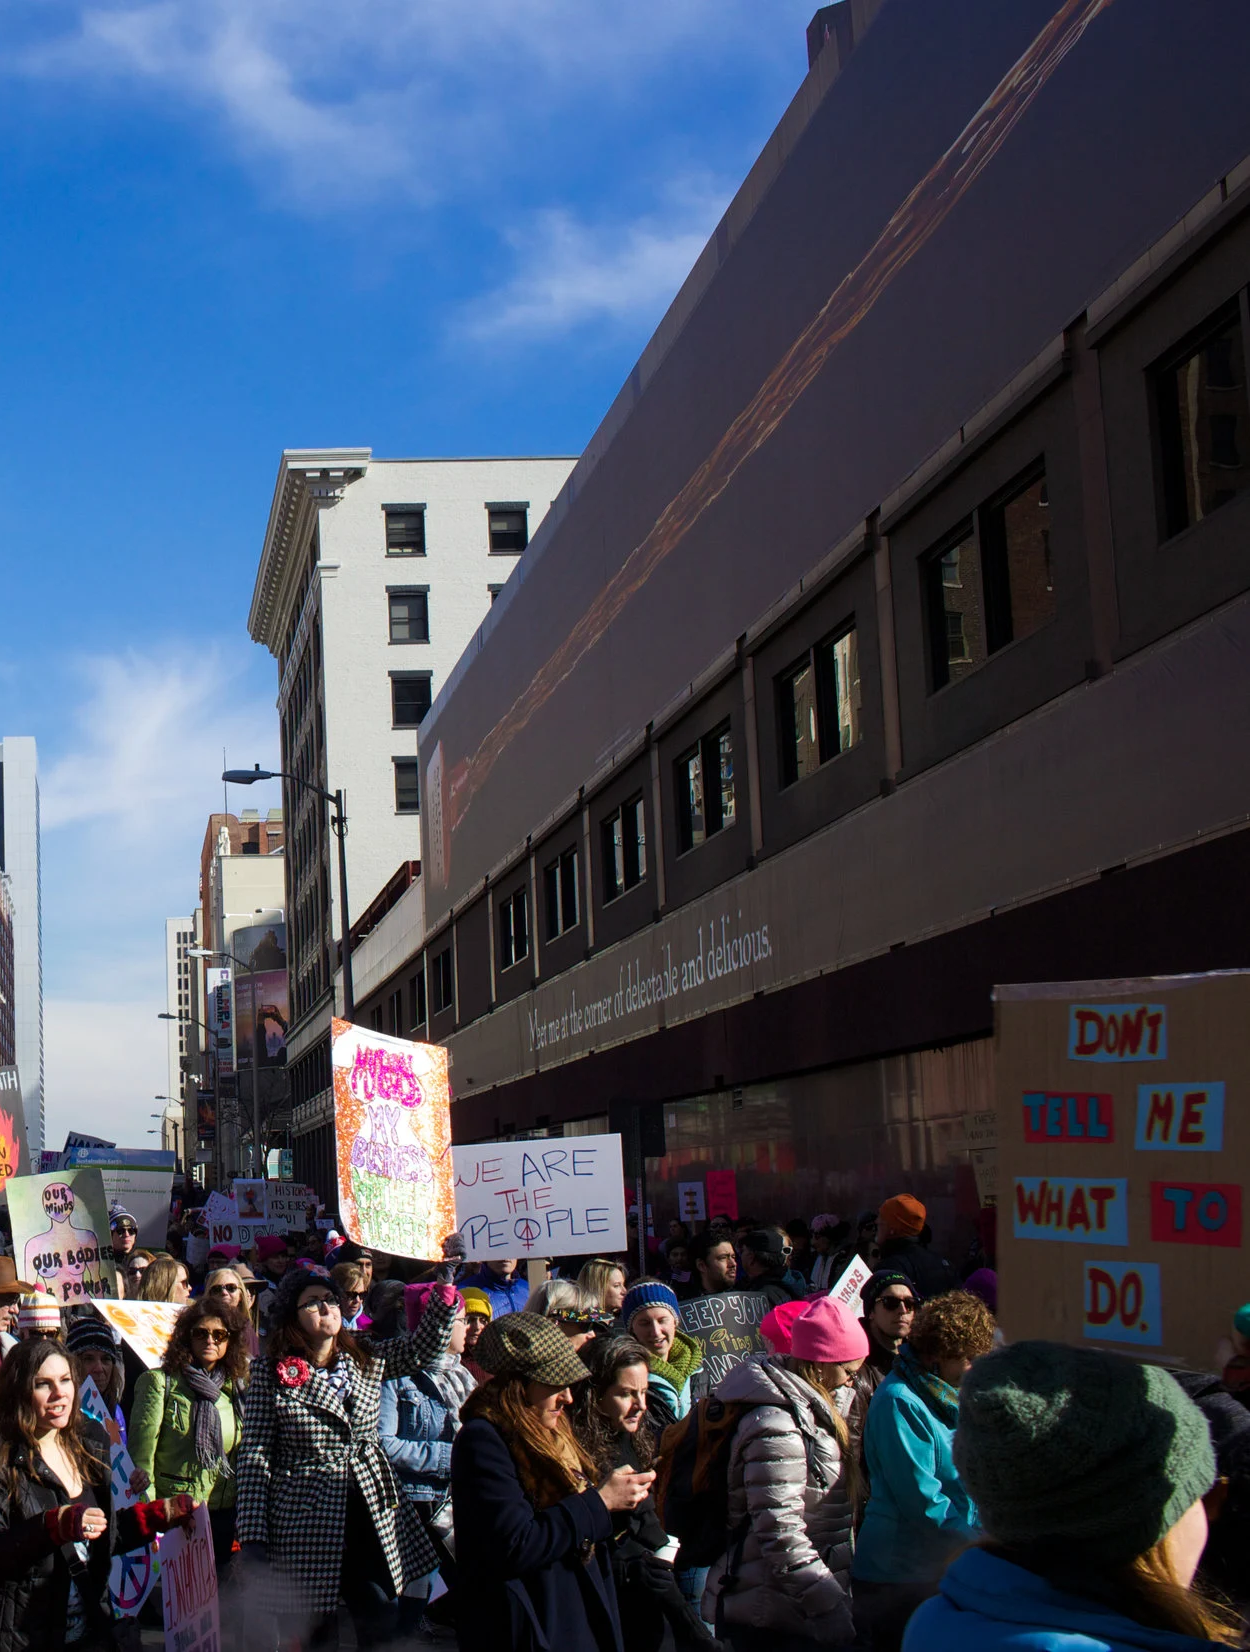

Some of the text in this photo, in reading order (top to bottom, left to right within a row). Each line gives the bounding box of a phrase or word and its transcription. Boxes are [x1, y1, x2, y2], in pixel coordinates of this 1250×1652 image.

[529, 1008, 548, 1051] Meet
[548, 1021, 560, 1044] me
[560, 1014, 569, 1041] at
[569, 990, 584, 1035] the
[584, 994, 612, 1030] corner
[614, 966, 624, 1019] of
[681, 926, 705, 991] and
[707, 909, 773, 981] delicious.
[1022, 1090, 1208, 1145] TELL ME
[454, 1149, 598, 1187] WE ARE
[44, 1186, 68, 1201] OUR
[494, 1186, 555, 1214] THE
[1015, 1179, 1229, 1234] WHAT TO
[213, 1225, 233, 1243] NO
[458, 1207, 611, 1251] PEOPLE
[32, 1245, 114, 1271] OUR BODIES
[61, 1277, 112, 1302] POWER
[1085, 1265, 1149, 1334] DO.
[678, 1297, 726, 1333] EEP
